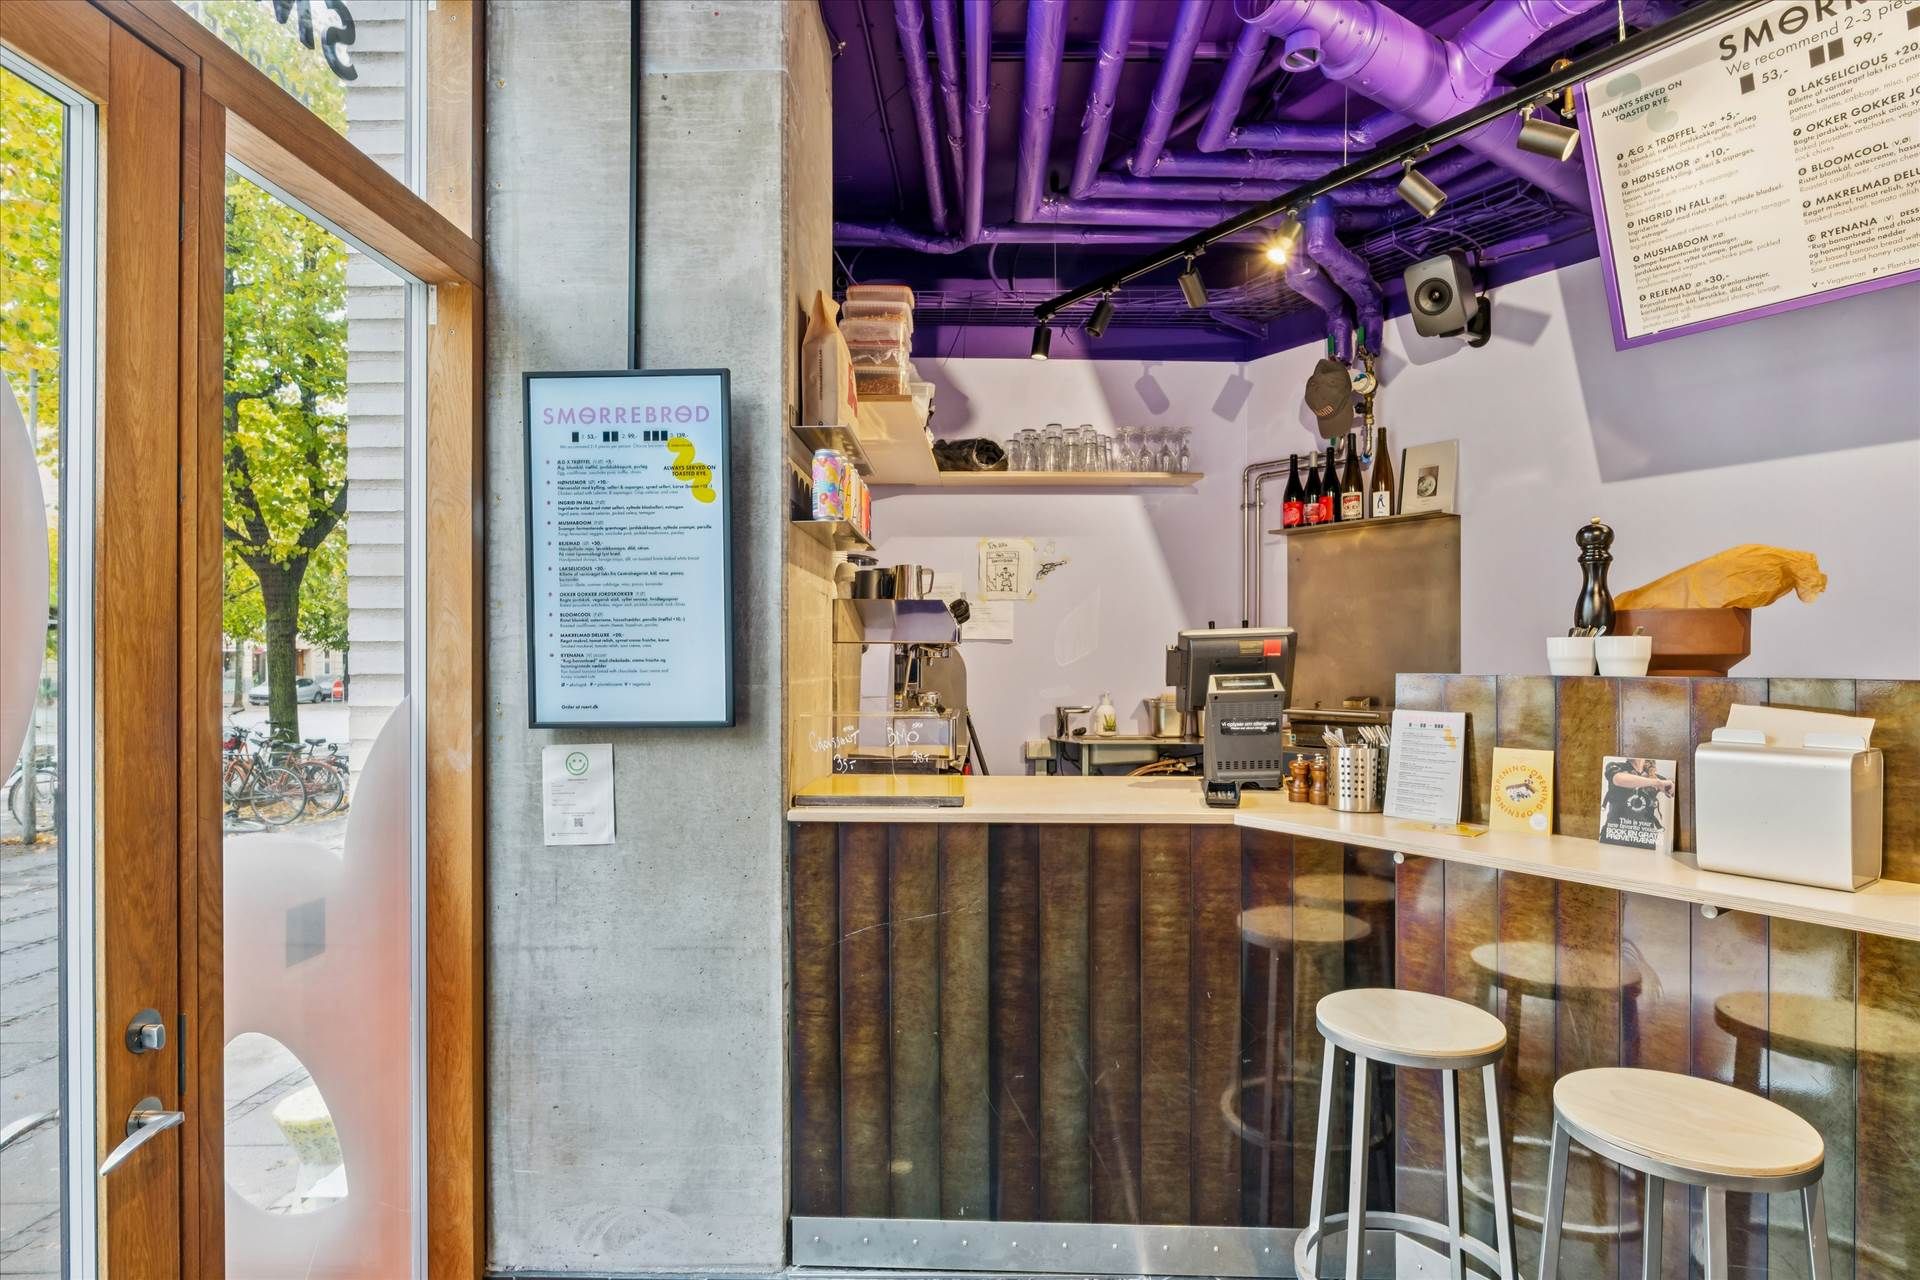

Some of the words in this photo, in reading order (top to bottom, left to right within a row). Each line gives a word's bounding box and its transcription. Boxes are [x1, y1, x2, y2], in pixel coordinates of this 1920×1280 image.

[1725, 61, 1750, 77] We
[1755, 22, 1839, 66] recommend
[1844, 9, 1872, 30] 2-3
[1762, 68, 1789, 84] 53,-
[1853, 31, 1884, 48] 99,-
[1800, 51, 1888, 94] LAKSELICIOUS
[1895, 42, 1920, 56] +20
[1824, 72, 1865, 95] varmrøget
[1866, 65, 1883, 78] laks
[1884, 60, 1896, 71] fra
[1601, 99, 1633, 119] ALWAYS
[1634, 85, 1666, 105] SERVED
[1667, 78, 1682, 91] ON
[1614, 101, 1650, 123] TOASTED
[1652, 93, 1670, 108] RYE.
[1815, 85, 1853, 105] koriander
[1733, 112, 1757, 128] purløg
[1805, 110, 1848, 133] OKKER
[1850, 90, 1906, 118] GOKKER
[1815, 120, 1851, 140] jordskok,
[1852, 109, 1886, 127] vegansk
[1888, 101, 1908, 114] aioli,
[1627, 144, 1644, 158] ÆG
[1655, 124, 1696, 147] TRØFFEL
[1719, 108, 1740, 124] +5,-
[1631, 157, 1689, 186] HØNSEMOR
[1705, 143, 1730, 161] +10,-
[1798, 173, 1818, 185] Ristet
[1818, 162, 1851, 179] blomkål,
[1853, 149, 1896, 169] ostecreme,
[1810, 140, 1888, 173] BLOOMCOOL
[1873, 157, 1897, 171] cream
[1815, 175, 1890, 206] MAKRELMAD
[1825, 196, 1854, 212] makrel,
[1855, 190, 1878, 202] tomat
[1879, 181, 1904, 196] relish,
[1869, 193, 1897, 206] tomato
[1637, 207, 1672, 226] INGRID
[1675, 203, 1686, 214] IN
[1689, 195, 1710, 209] FALL
[1675, 212, 1690, 221] med
[1730, 191, 1754, 205] syltede
[1820, 216, 1877, 239] RYENANA
[1876, 221, 1895, 232] med
[1642, 233, 1708, 260] MUSHABOOM
[1728, 237, 1753, 250] persille
[1808, 251, 1818, 259] og
[1819, 235, 1876, 256] honningristede
[1876, 226, 1907, 240] nødder
[1849, 243, 1878, 256] banana
[1879, 236, 1903, 247] bread
[1851, 254, 1866, 263] and
[1867, 248, 1891, 260] honey
[1649, 281, 1691, 299] REJEMAD
[1704, 271, 1730, 285] +30,-
[1744, 279, 1764, 290] citron
[1826, 270, 1866, 285] Vegetarian
[543, 405, 710, 425] SMØRREBRØD
[1606, 827, 1627, 835] BOOK
[1620, 817, 1632, 825] This
[1638, 820, 1652, 828] your
